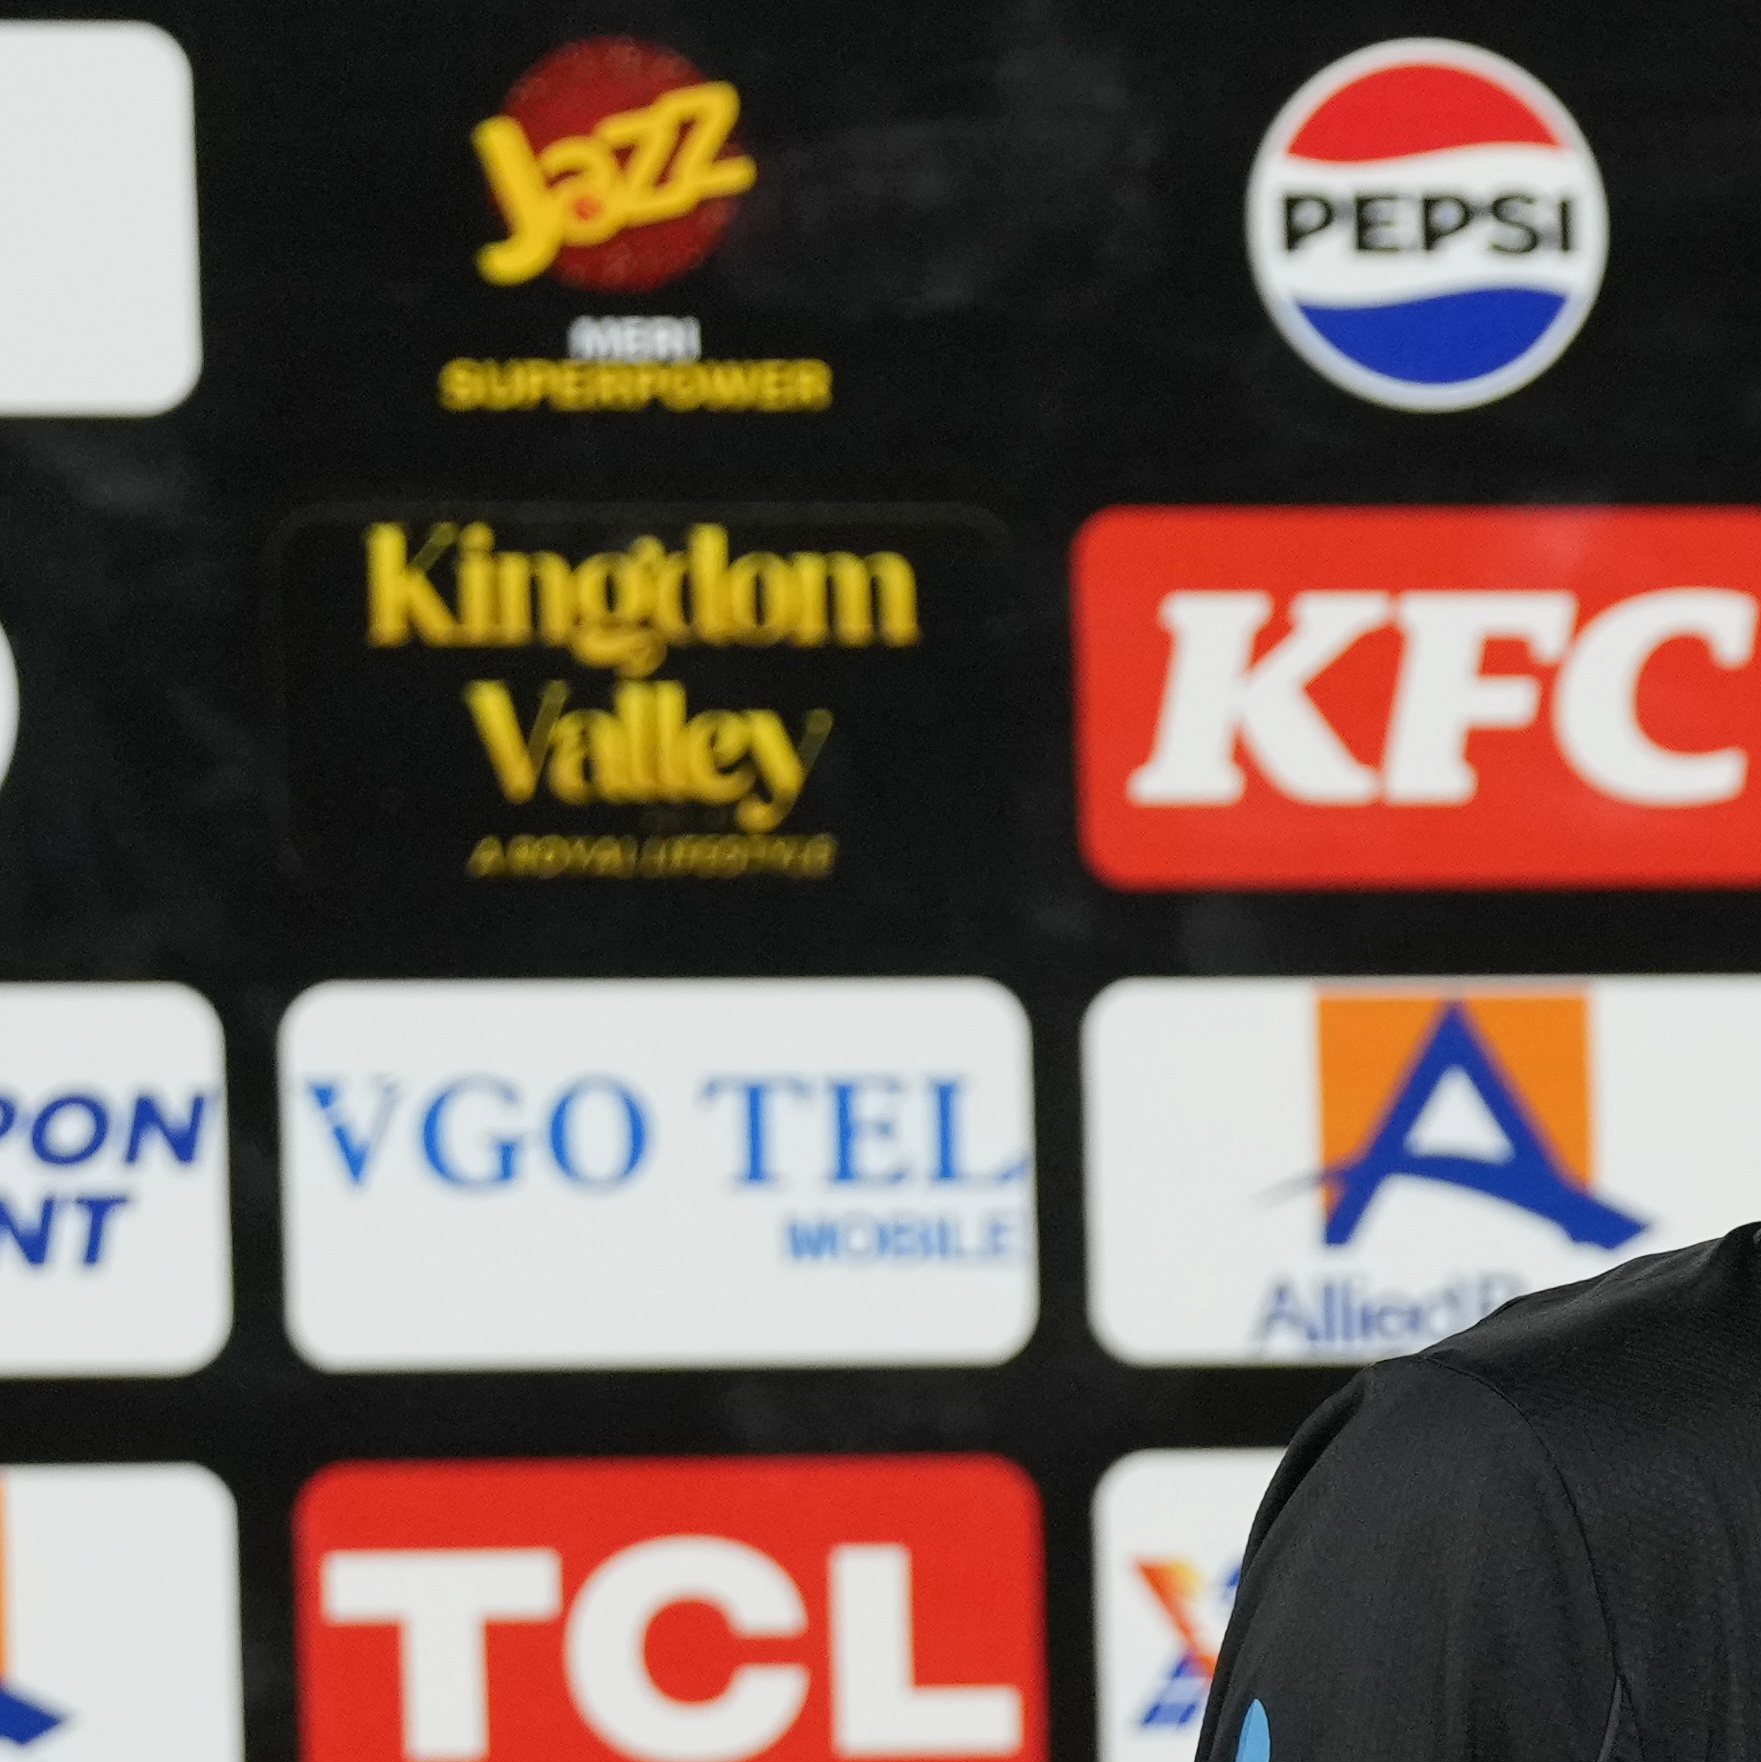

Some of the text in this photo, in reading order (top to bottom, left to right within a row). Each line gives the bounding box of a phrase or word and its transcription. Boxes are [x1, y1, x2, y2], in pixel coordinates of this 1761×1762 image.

[470, 81, 757, 286] Jazz
[1281, 191, 1575, 257] PEPSI
[439, 358, 833, 411] SUPERPOWER
[364, 521, 920, 677] Kingdom
[463, 679, 834, 830] Valley
[1127, 586, 1760, 806] KFC
[304, 1070, 1030, 1193] VGO TEL
[785, 1212, 1019, 1266] MOBILE
